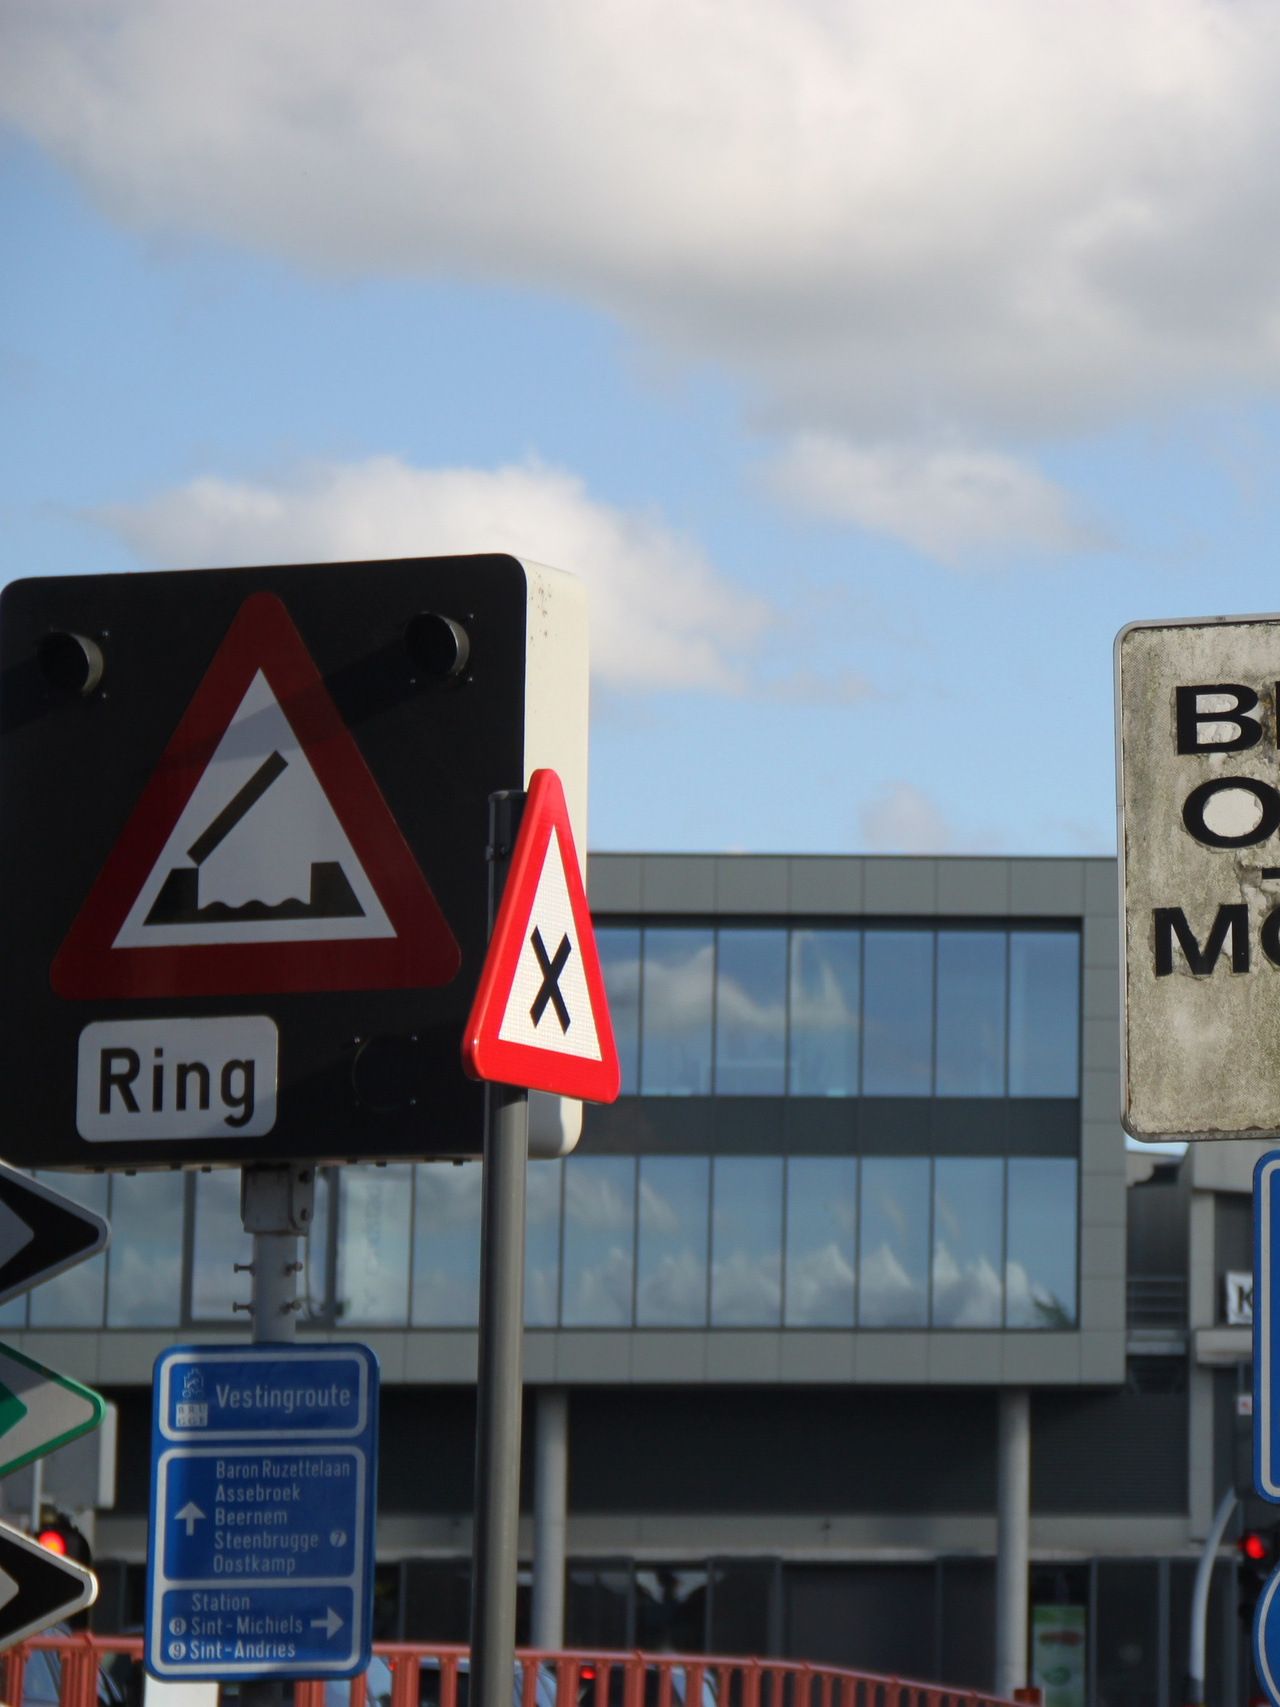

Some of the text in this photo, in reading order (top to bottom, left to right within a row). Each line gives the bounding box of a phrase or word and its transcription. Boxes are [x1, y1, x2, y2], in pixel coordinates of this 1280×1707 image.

[99, 1046, 256, 1128] Ring
[216, 1383, 350, 1414] Vestingroute
[216, 1459, 350, 1479] Baron Ruzettelaan
[215, 1484, 301, 1502] Assebroek
[214, 1507, 288, 1526] Beernem
[214, 1531, 319, 1552] Steenbrugge
[213, 1555, 297, 1576] Oostkamp
[191, 1593, 250, 1612] Station
